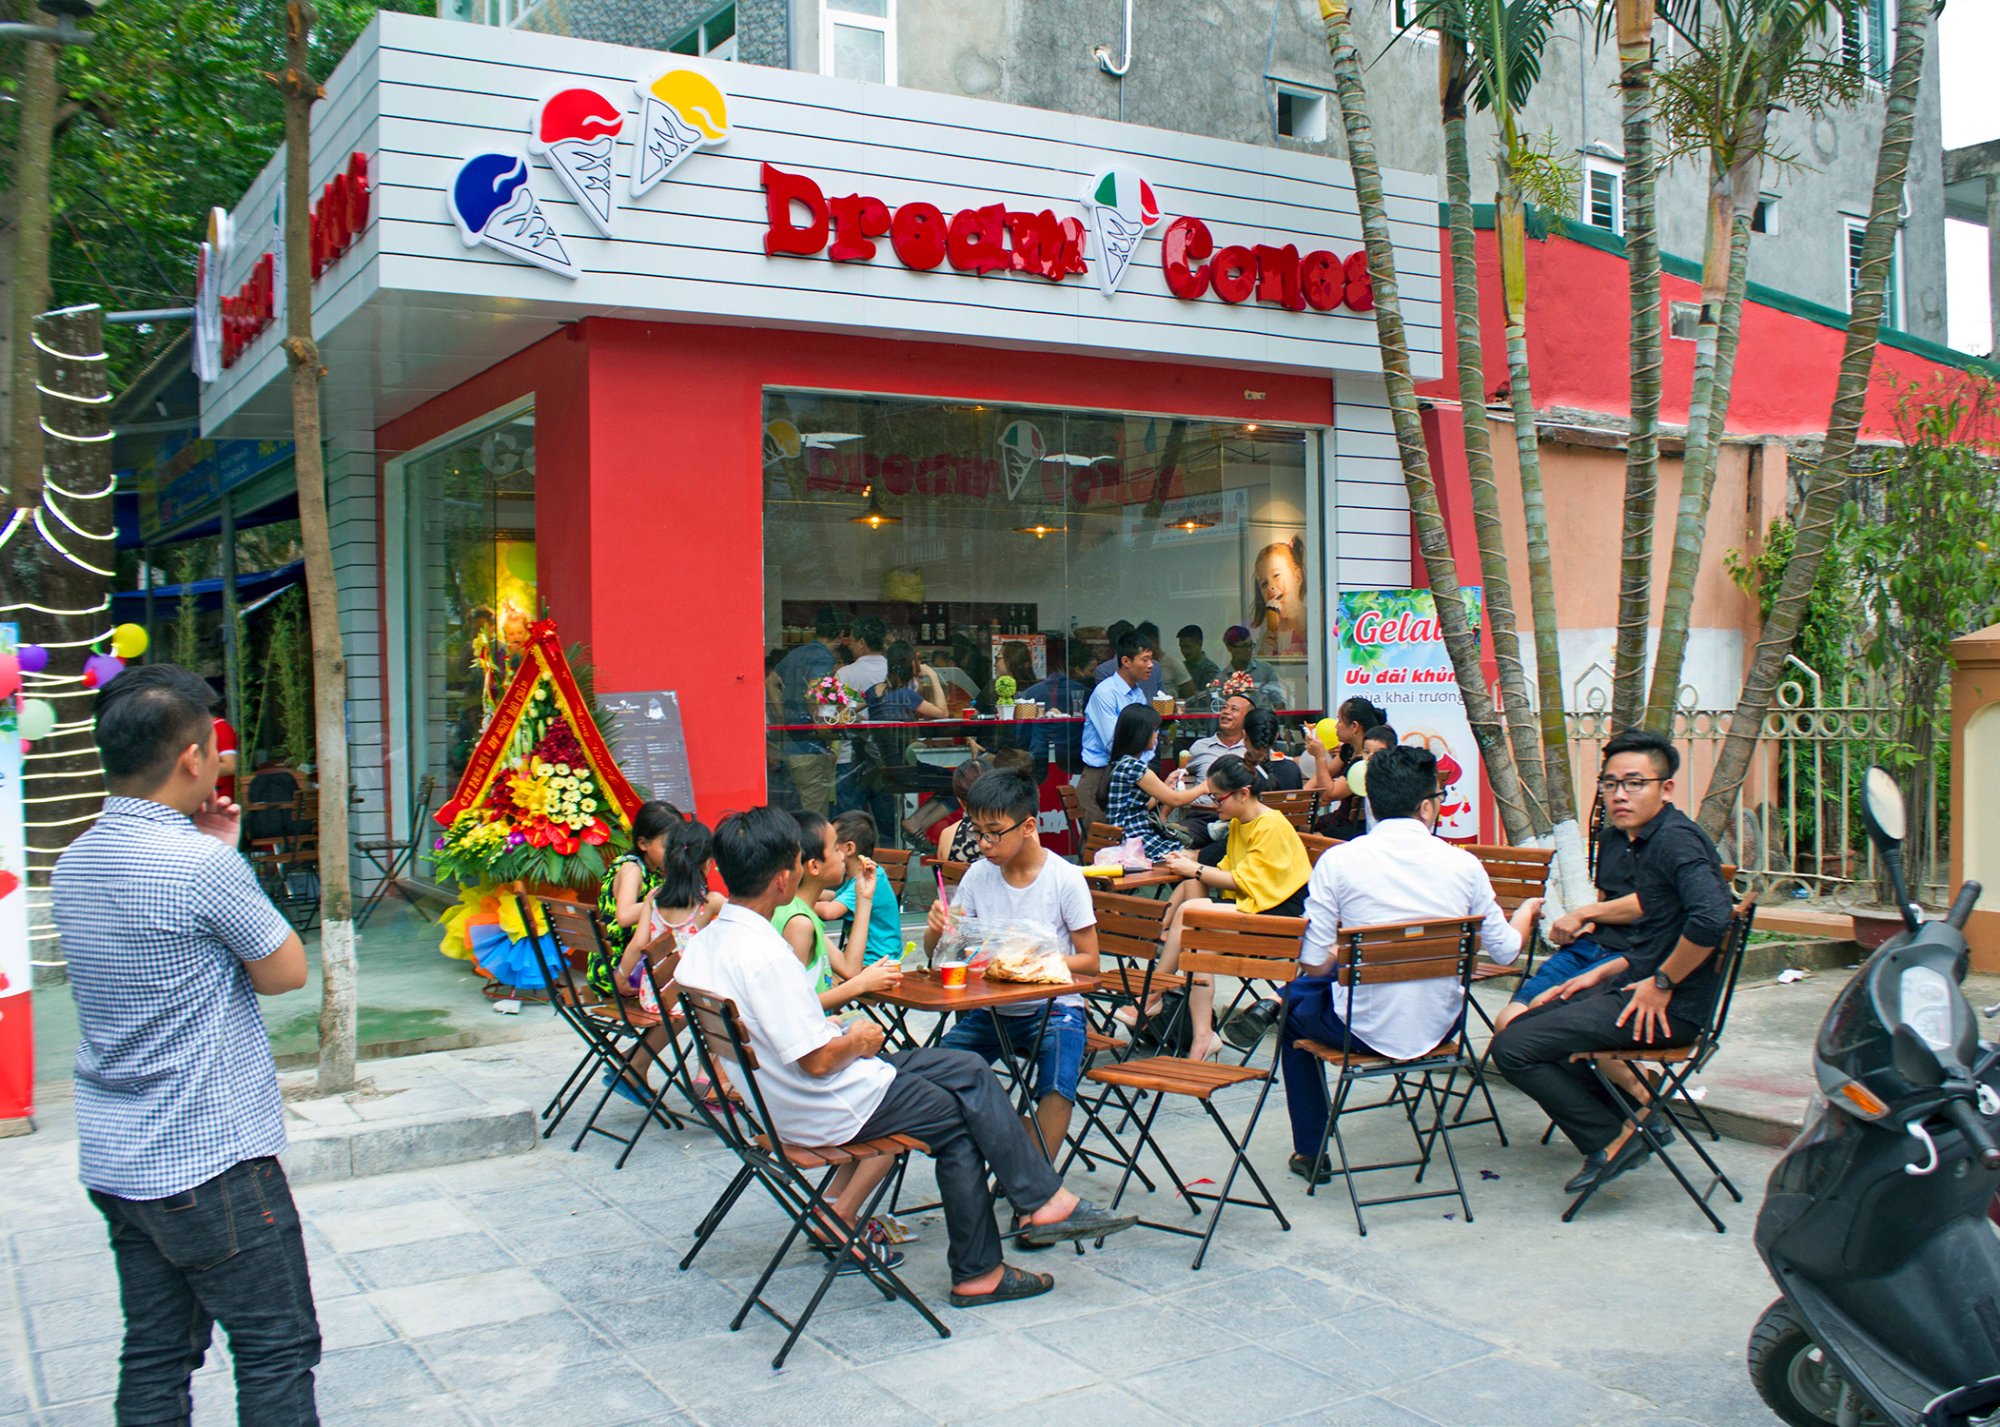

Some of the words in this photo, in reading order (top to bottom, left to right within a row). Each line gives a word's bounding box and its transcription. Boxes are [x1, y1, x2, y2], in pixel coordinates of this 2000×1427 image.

[761, 161, 1088, 282] Dream
[1346, 667, 1370, 684] Ưu
[1376, 667, 1407, 684] đãi
[1385, 691, 1414, 703] khai
